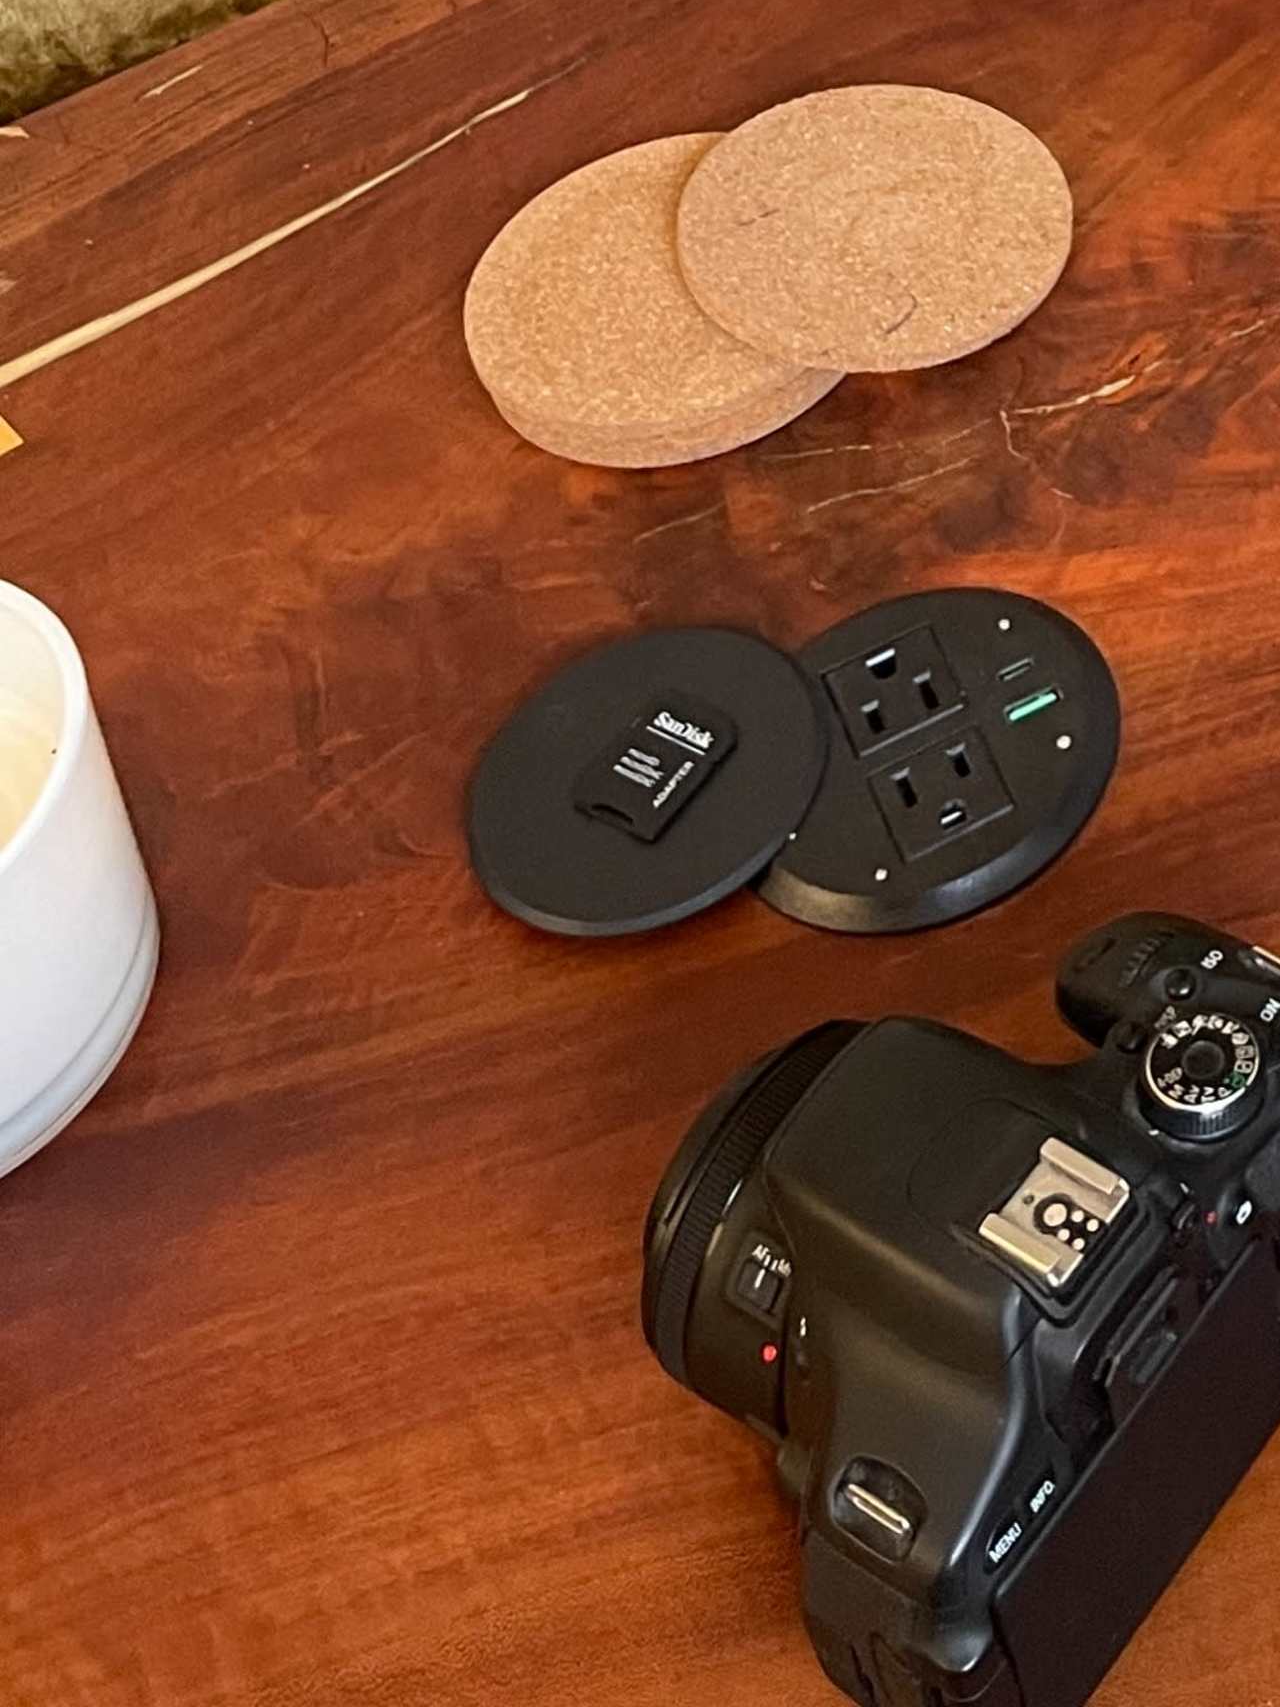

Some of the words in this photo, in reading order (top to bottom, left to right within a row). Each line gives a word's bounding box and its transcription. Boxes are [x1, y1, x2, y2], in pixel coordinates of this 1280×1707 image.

[653, 710, 714, 749] SanDisk
[653, 761, 694, 808] ADAPTER
[1201, 949, 1223, 969] ISO
[1260, 998, 1280, 1022] ON
[989, 1522, 1022, 1563] MENU
